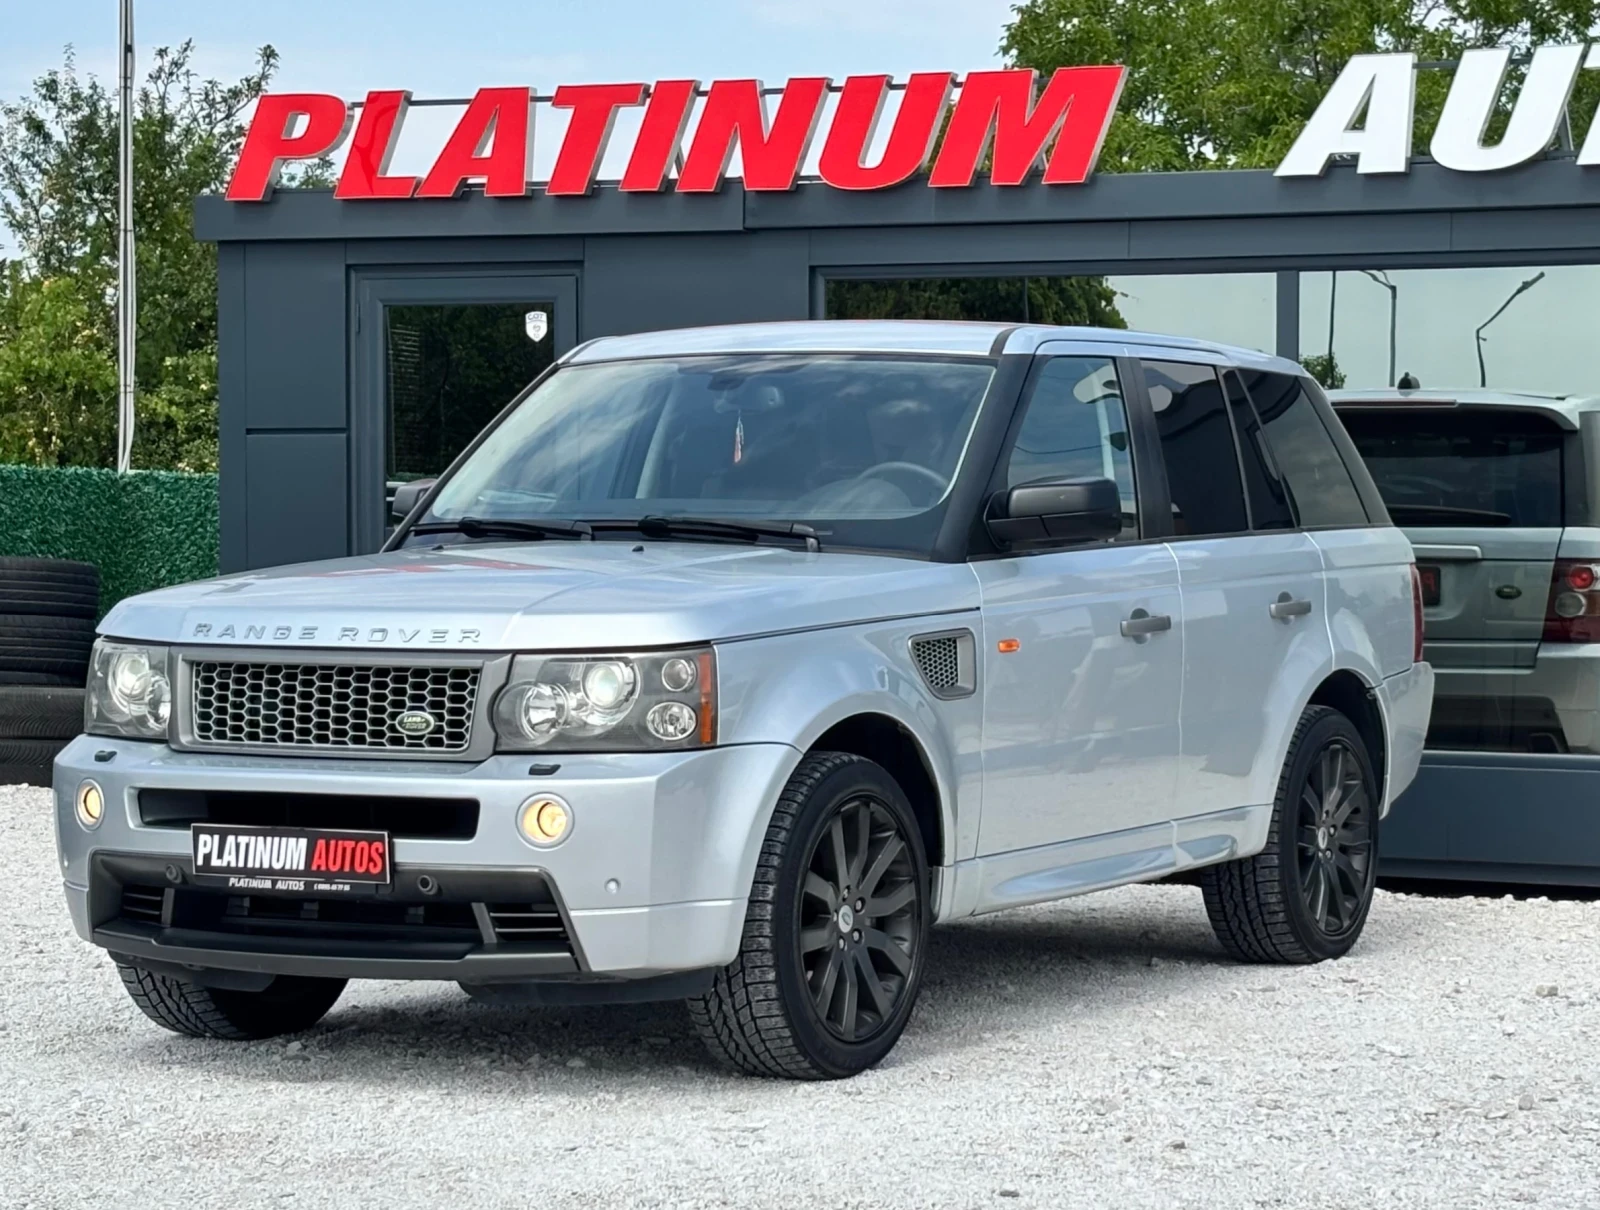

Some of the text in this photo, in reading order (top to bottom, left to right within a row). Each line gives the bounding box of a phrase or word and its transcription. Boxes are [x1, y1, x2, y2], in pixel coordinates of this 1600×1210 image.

[224, 41, 1600, 202] PLATINUM AU
[192, 622, 481, 644] RANGE ROVER
[196, 833, 384, 875] PLATINUM AUTOS
[228, 877, 272, 889] PLATINUM
[275, 880, 305, 891] AUTOS
